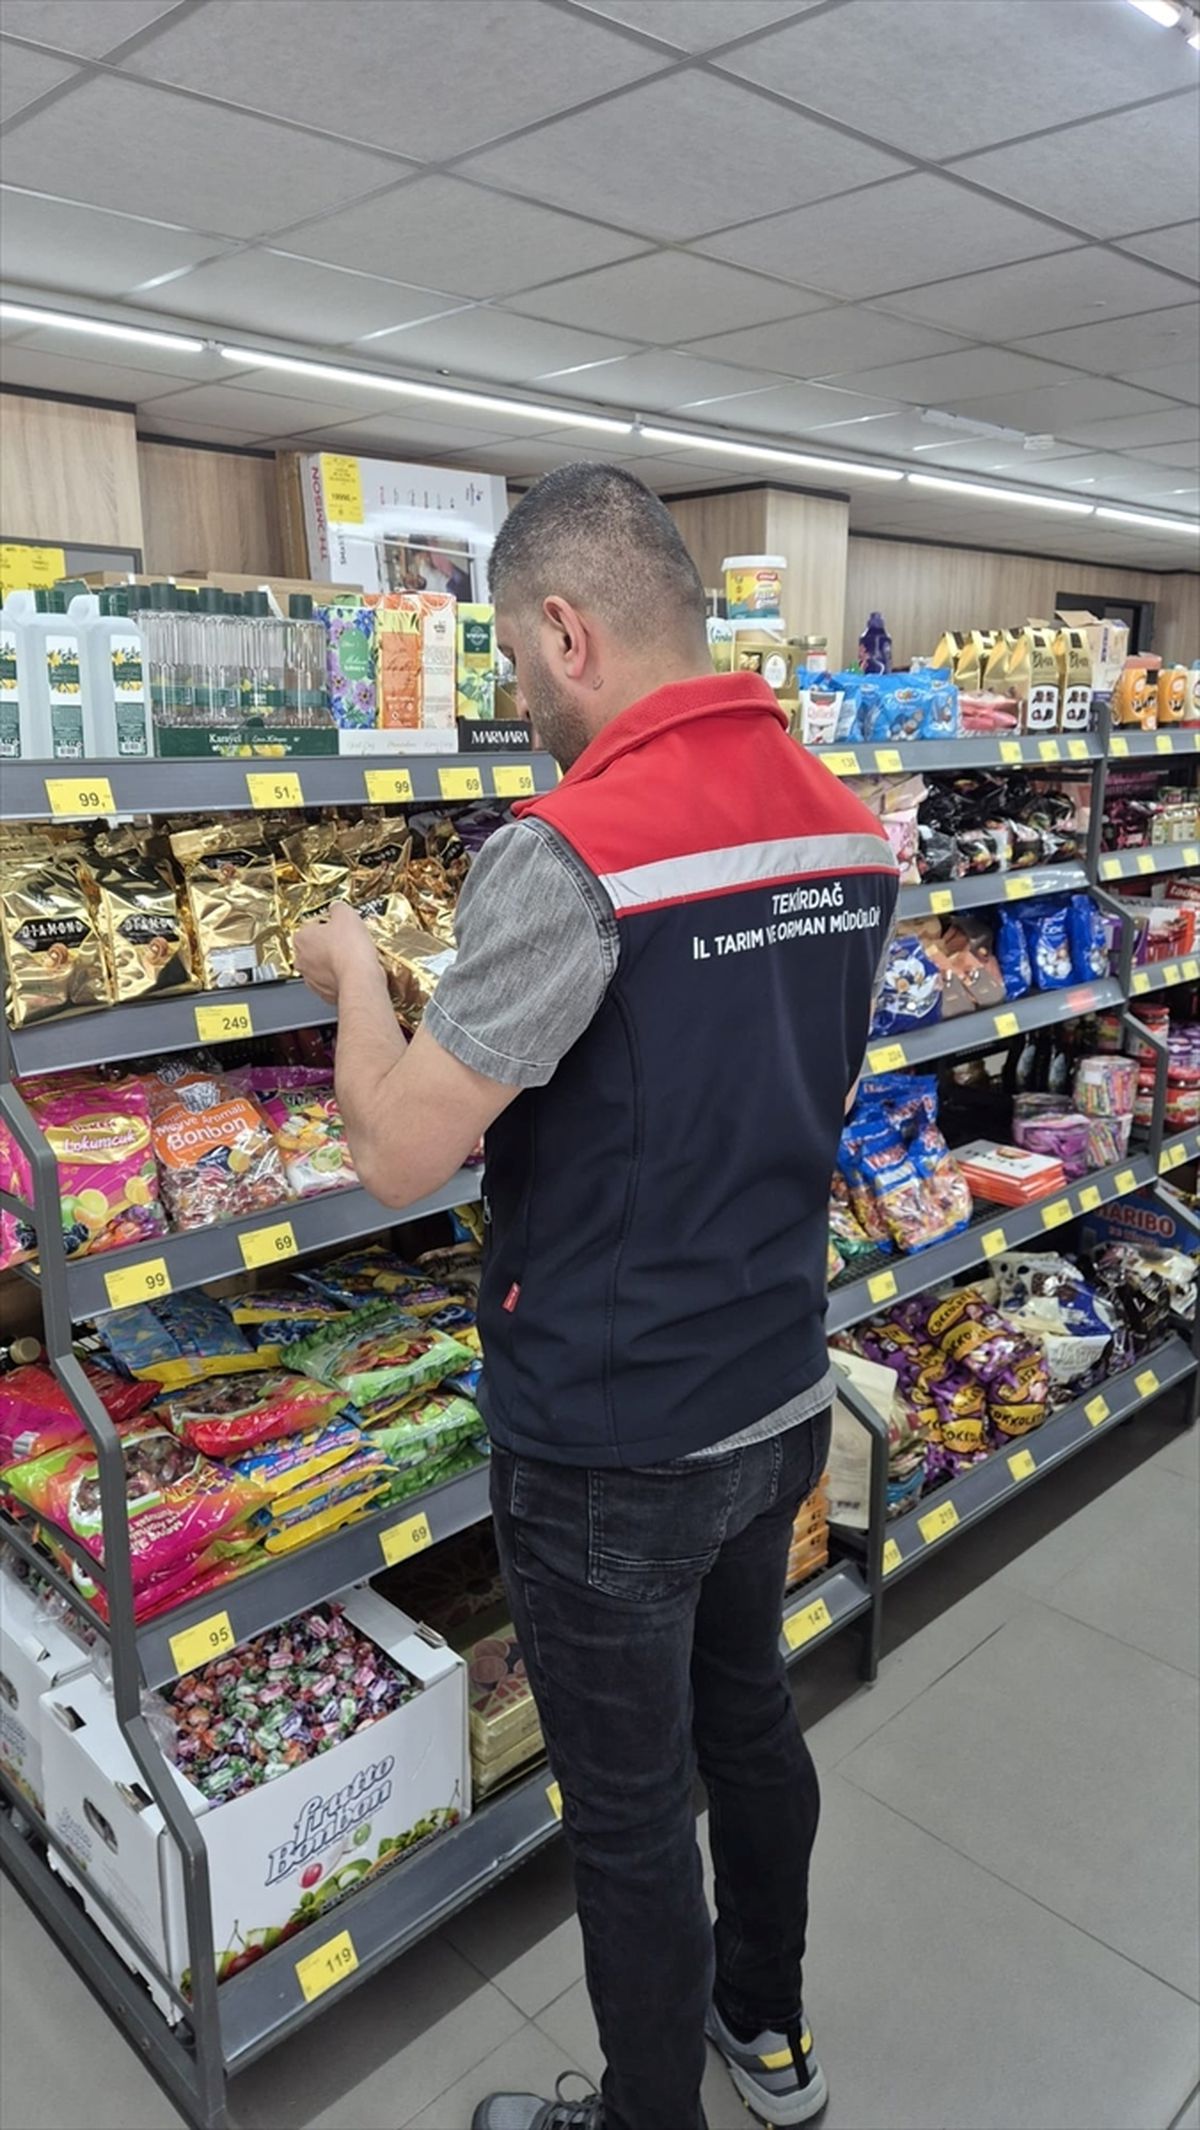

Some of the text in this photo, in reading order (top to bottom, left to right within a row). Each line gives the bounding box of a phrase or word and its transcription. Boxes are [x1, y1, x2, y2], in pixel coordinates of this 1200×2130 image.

[471, 731, 529, 744] MARMARA
[394, 780, 410, 793] 99
[466, 778, 480, 791] 69
[519, 776, 532, 789] 59
[771, 881, 844, 916] TEKİRDAĞ
[21, 922, 84, 938] DIAMOND
[692, 936, 711, 960] İL
[714, 927, 764, 956] TARIM
[777, 916, 826, 942] ORMAN
[222, 1016, 248, 1030] 249
[64, 1129, 136, 1153] Lokumcuk
[167, 1115, 248, 1152] Bonbon
[274, 1235, 293, 1251] 69
[145, 1272, 167, 1290] 99
[411, 1525, 427, 1543] 69
[209, 1627, 229, 1647] 95
[293, 1755, 395, 1846] frutto
[264, 1779, 393, 1887] Bonbon
[325, 1947, 351, 1974] 119
